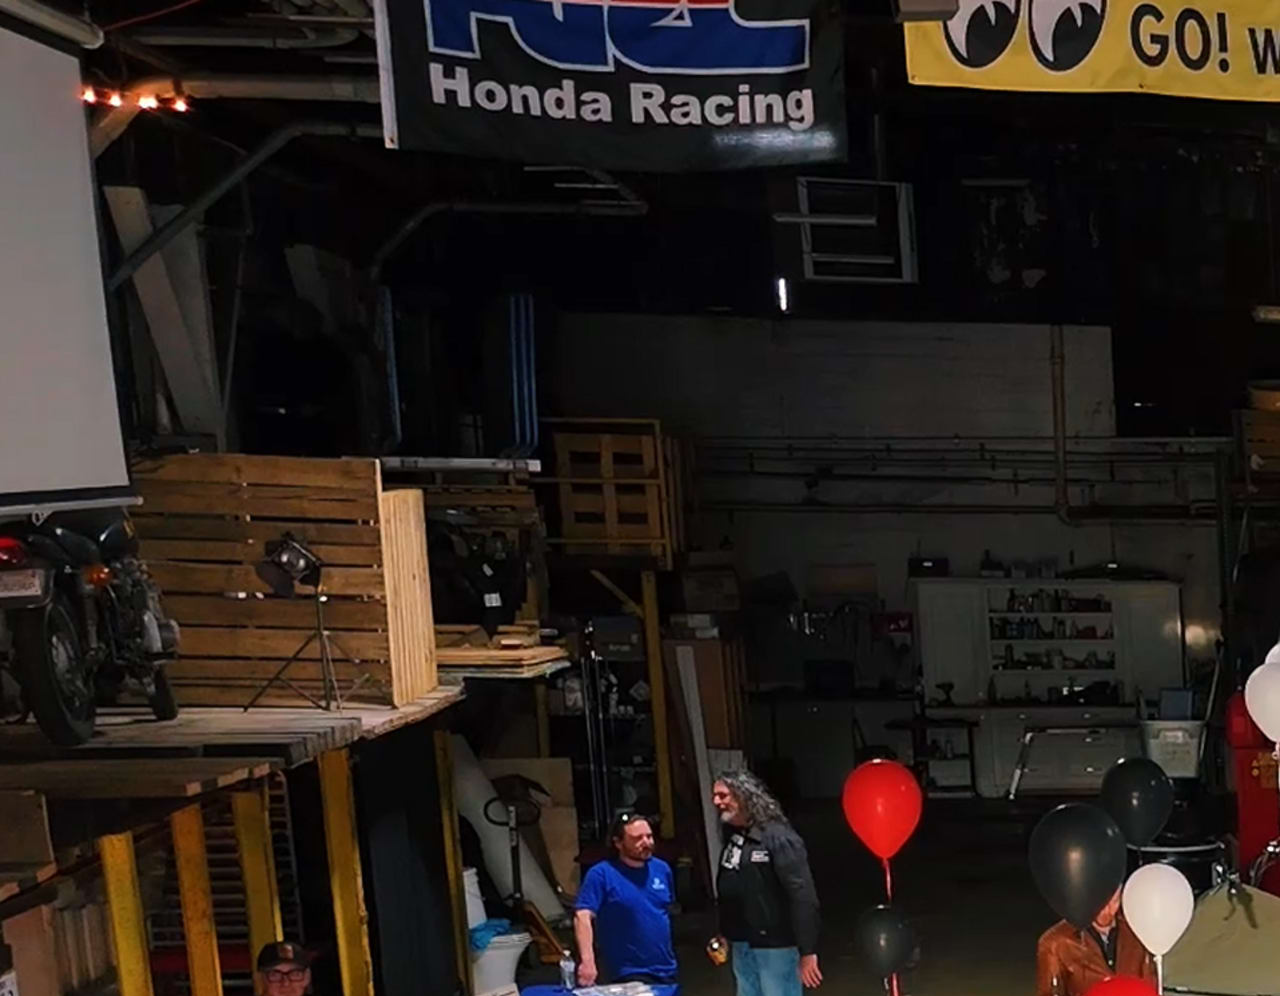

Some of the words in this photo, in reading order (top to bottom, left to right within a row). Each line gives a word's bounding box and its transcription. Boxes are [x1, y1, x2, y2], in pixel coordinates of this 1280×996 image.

[1130, 3, 1229, 74] GO!
[428, 62, 613, 123] Honda
[629, 82, 815, 131] Racing
